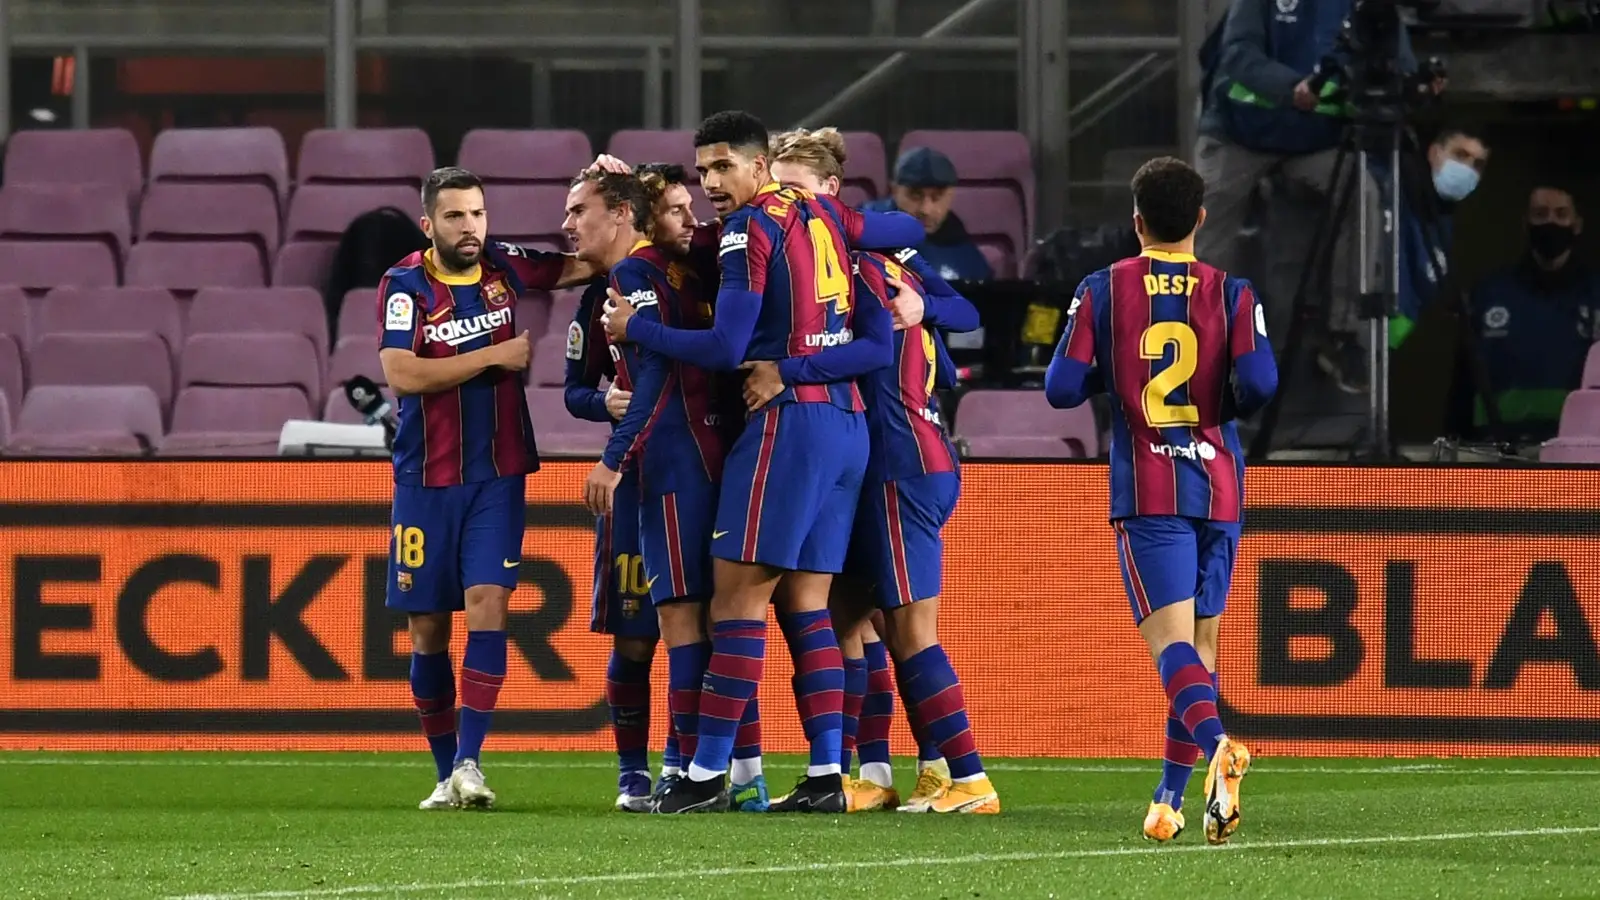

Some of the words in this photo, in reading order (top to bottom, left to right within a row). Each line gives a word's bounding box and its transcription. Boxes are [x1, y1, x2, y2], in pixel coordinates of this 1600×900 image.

[808, 217, 851, 315] 4
[1143, 274, 1199, 296] DEST
[422, 306, 512, 344] Rakuten
[1139, 321, 1200, 428] 2
[394, 523, 425, 568] 18
[1258, 558, 1600, 691] BLA
